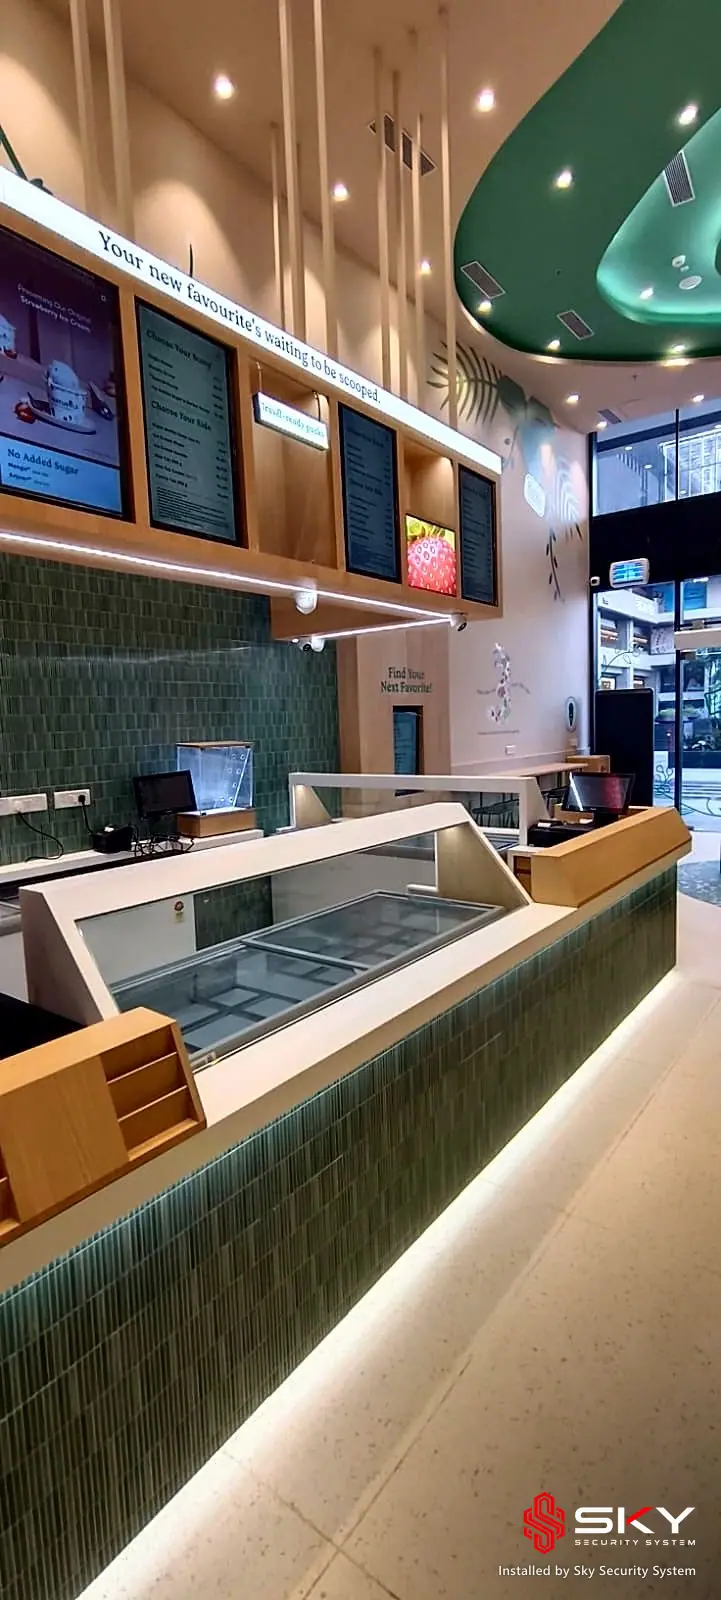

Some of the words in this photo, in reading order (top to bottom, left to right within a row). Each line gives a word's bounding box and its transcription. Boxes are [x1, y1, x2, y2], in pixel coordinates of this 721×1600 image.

[99, 230, 143, 269] Your
[149, 264, 182, 292] new
[187, 283, 262, 338] favourite's
[265, 330, 308, 367] waiting
[311, 355, 322, 370] to
[324, 359, 337, 379] be
[339, 372, 381, 404] scooped.
[152, 401, 178, 418] Choose
[180, 411, 195, 424] Your
[8, 448, 20, 459] No
[23, 452, 52, 468] Added
[54, 461, 79, 476] Sugar
[388, 666, 406, 679] Find
[408, 668, 425, 680] Your
[381, 680, 399, 693] Next
[400, 681, 432, 693] Favorite!
